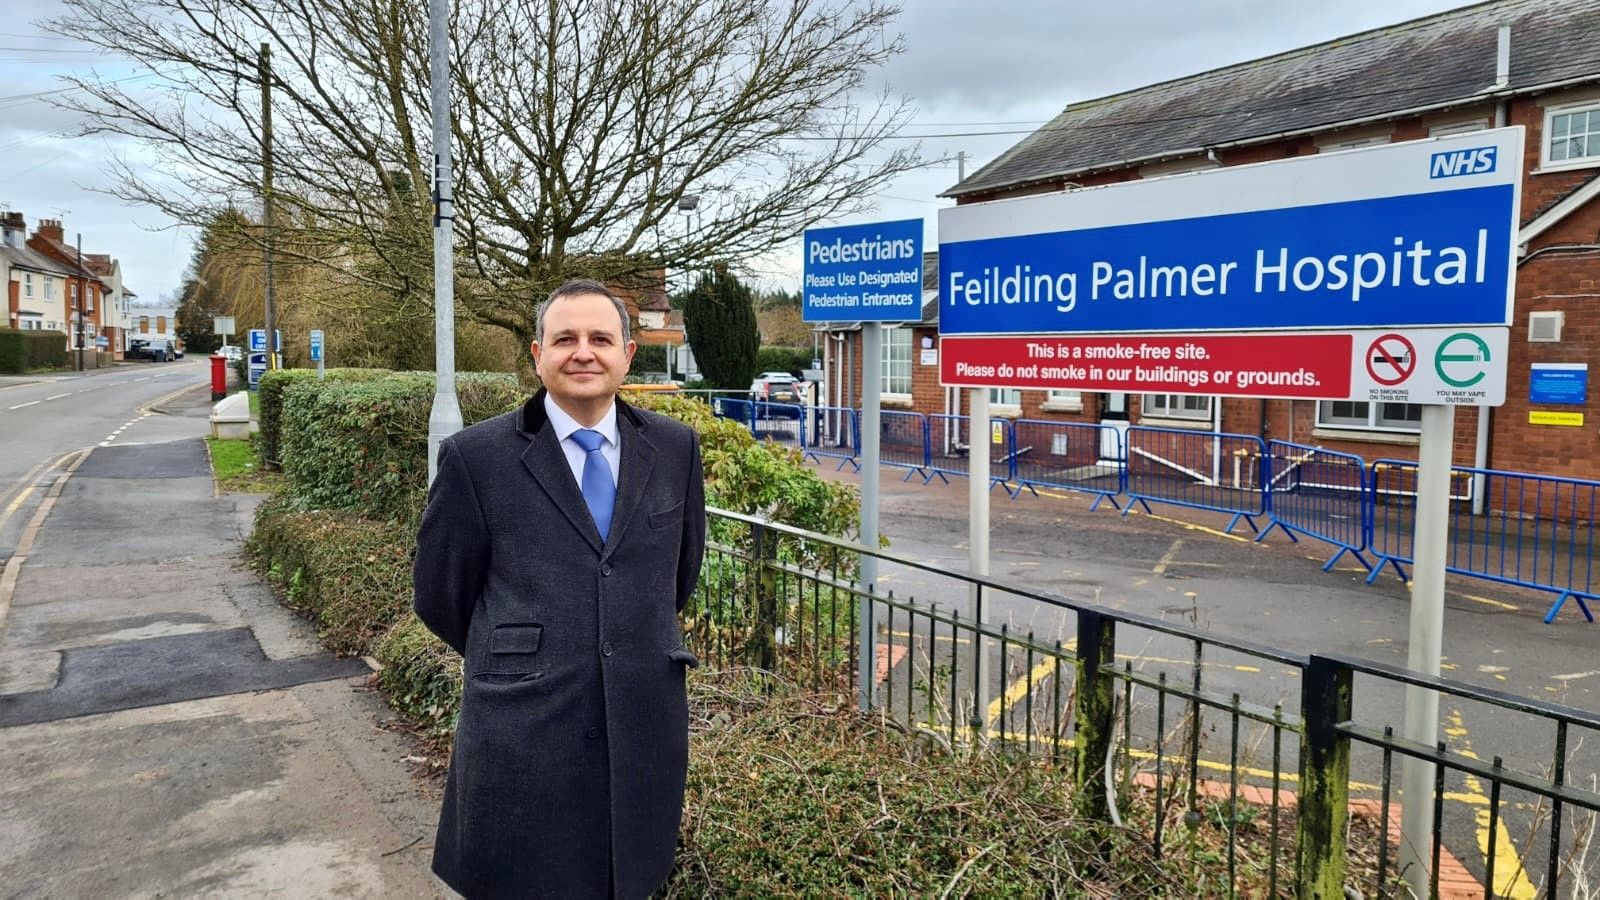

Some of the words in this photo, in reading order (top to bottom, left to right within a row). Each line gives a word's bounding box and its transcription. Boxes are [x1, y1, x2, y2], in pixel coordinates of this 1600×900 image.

[1431, 148, 1495, 177] NHS
[809, 234, 914, 265] Pedestrians
[806, 273, 836, 288] Please
[837, 272, 856, 286] Use
[858, 267, 919, 288] Designated
[950, 265, 1077, 313] Feilding
[1091, 255, 1238, 300] Palmer
[1254, 228, 1488, 302] Hospital
[809, 292, 860, 307] Pedestrian
[862, 292, 914, 306] Entrances
[1026, 343, 1054, 358] This
[1058, 343, 1070, 358] is
[1072, 347, 1082, 359] a
[1084, 343, 1171, 359] smoke-free
[1175, 343, 1211, 359] site.
[956, 362, 995, 377] Please
[997, 363, 1013, 378] do
[1016, 365, 1039, 378] not
[1041, 365, 1087, 380] smoke
[1089, 365, 1103, 380] in
[1106, 367, 1132, 381] our
[1135, 365, 1209, 387] buildings
[1213, 369, 1233, 384] or
[1236, 368, 1321, 388] grounds.
